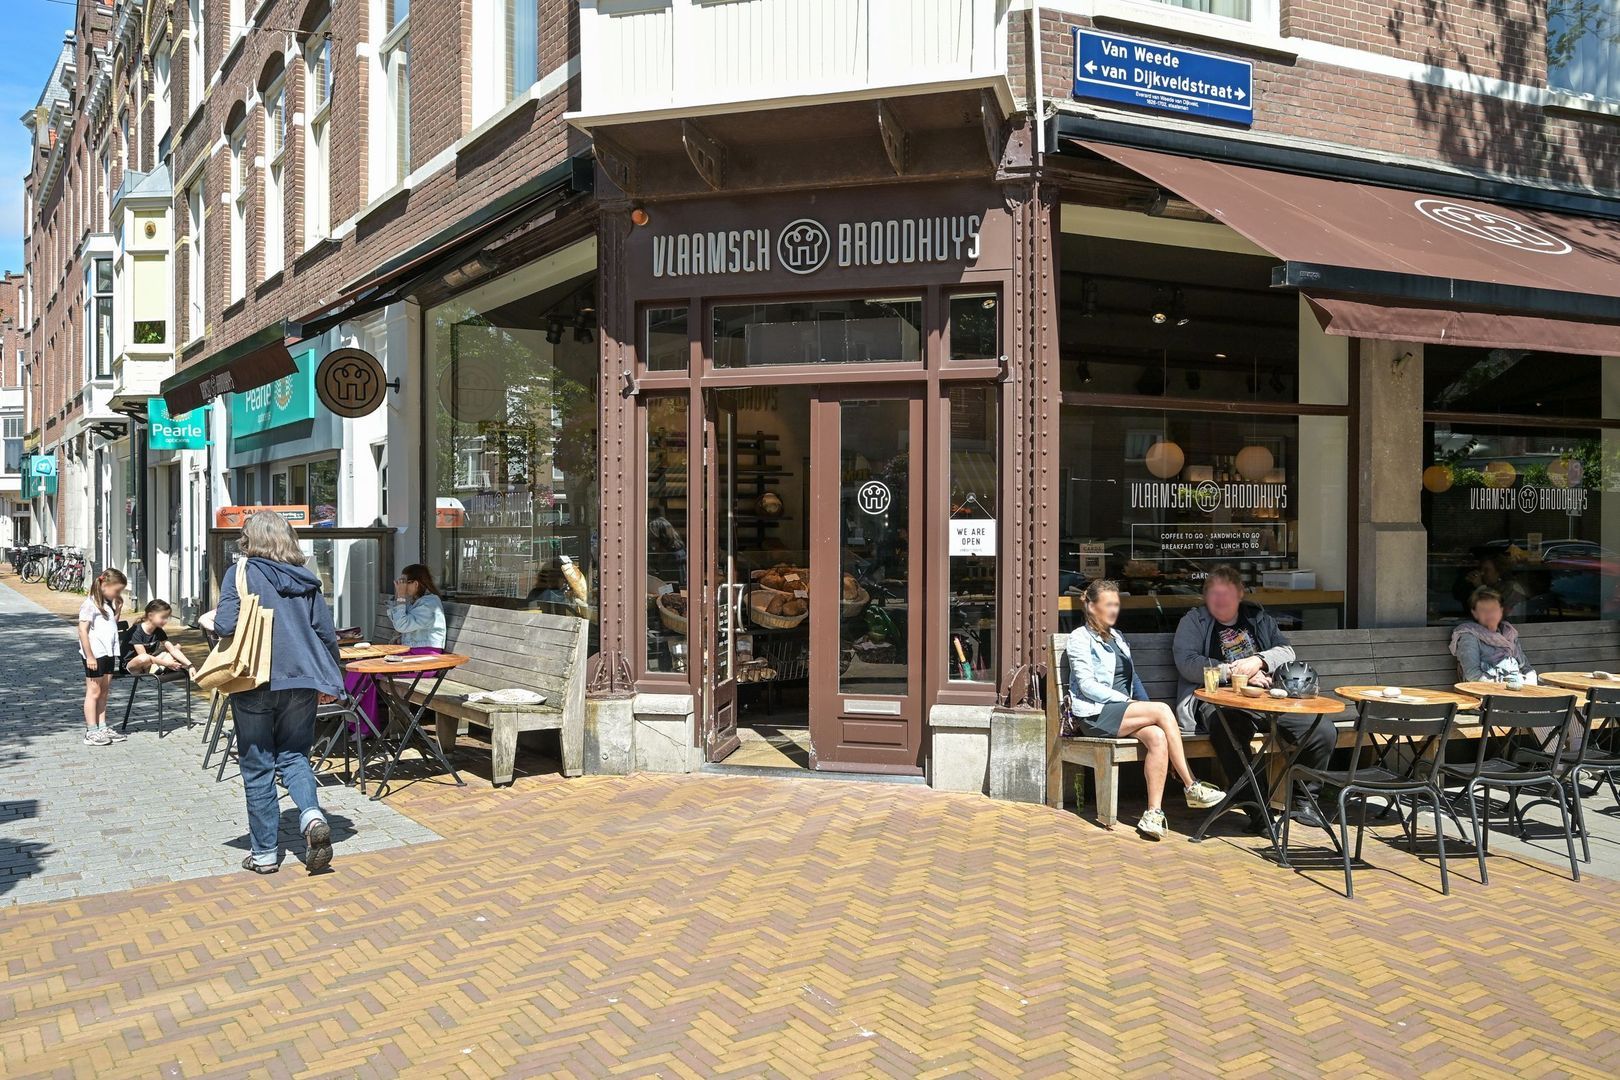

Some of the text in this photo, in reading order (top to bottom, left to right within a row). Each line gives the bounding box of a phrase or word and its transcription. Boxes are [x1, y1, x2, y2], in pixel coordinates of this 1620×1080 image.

[1101, 40, 1180, 68] Van Weede
[1101, 65, 1233, 99] van Dijkveldstraat
[653, 214, 981, 278] VLAAMSCH BROODHUYS
[152, 423, 202, 437] Pearle
[1131, 482, 1288, 509] VLAAMSCH BROODHUYS
[1470, 487, 1588, 510] VLAAMSCH BROODHUYS
[956, 527, 986, 536] WE ARE
[961, 537, 981, 546] OPEN
